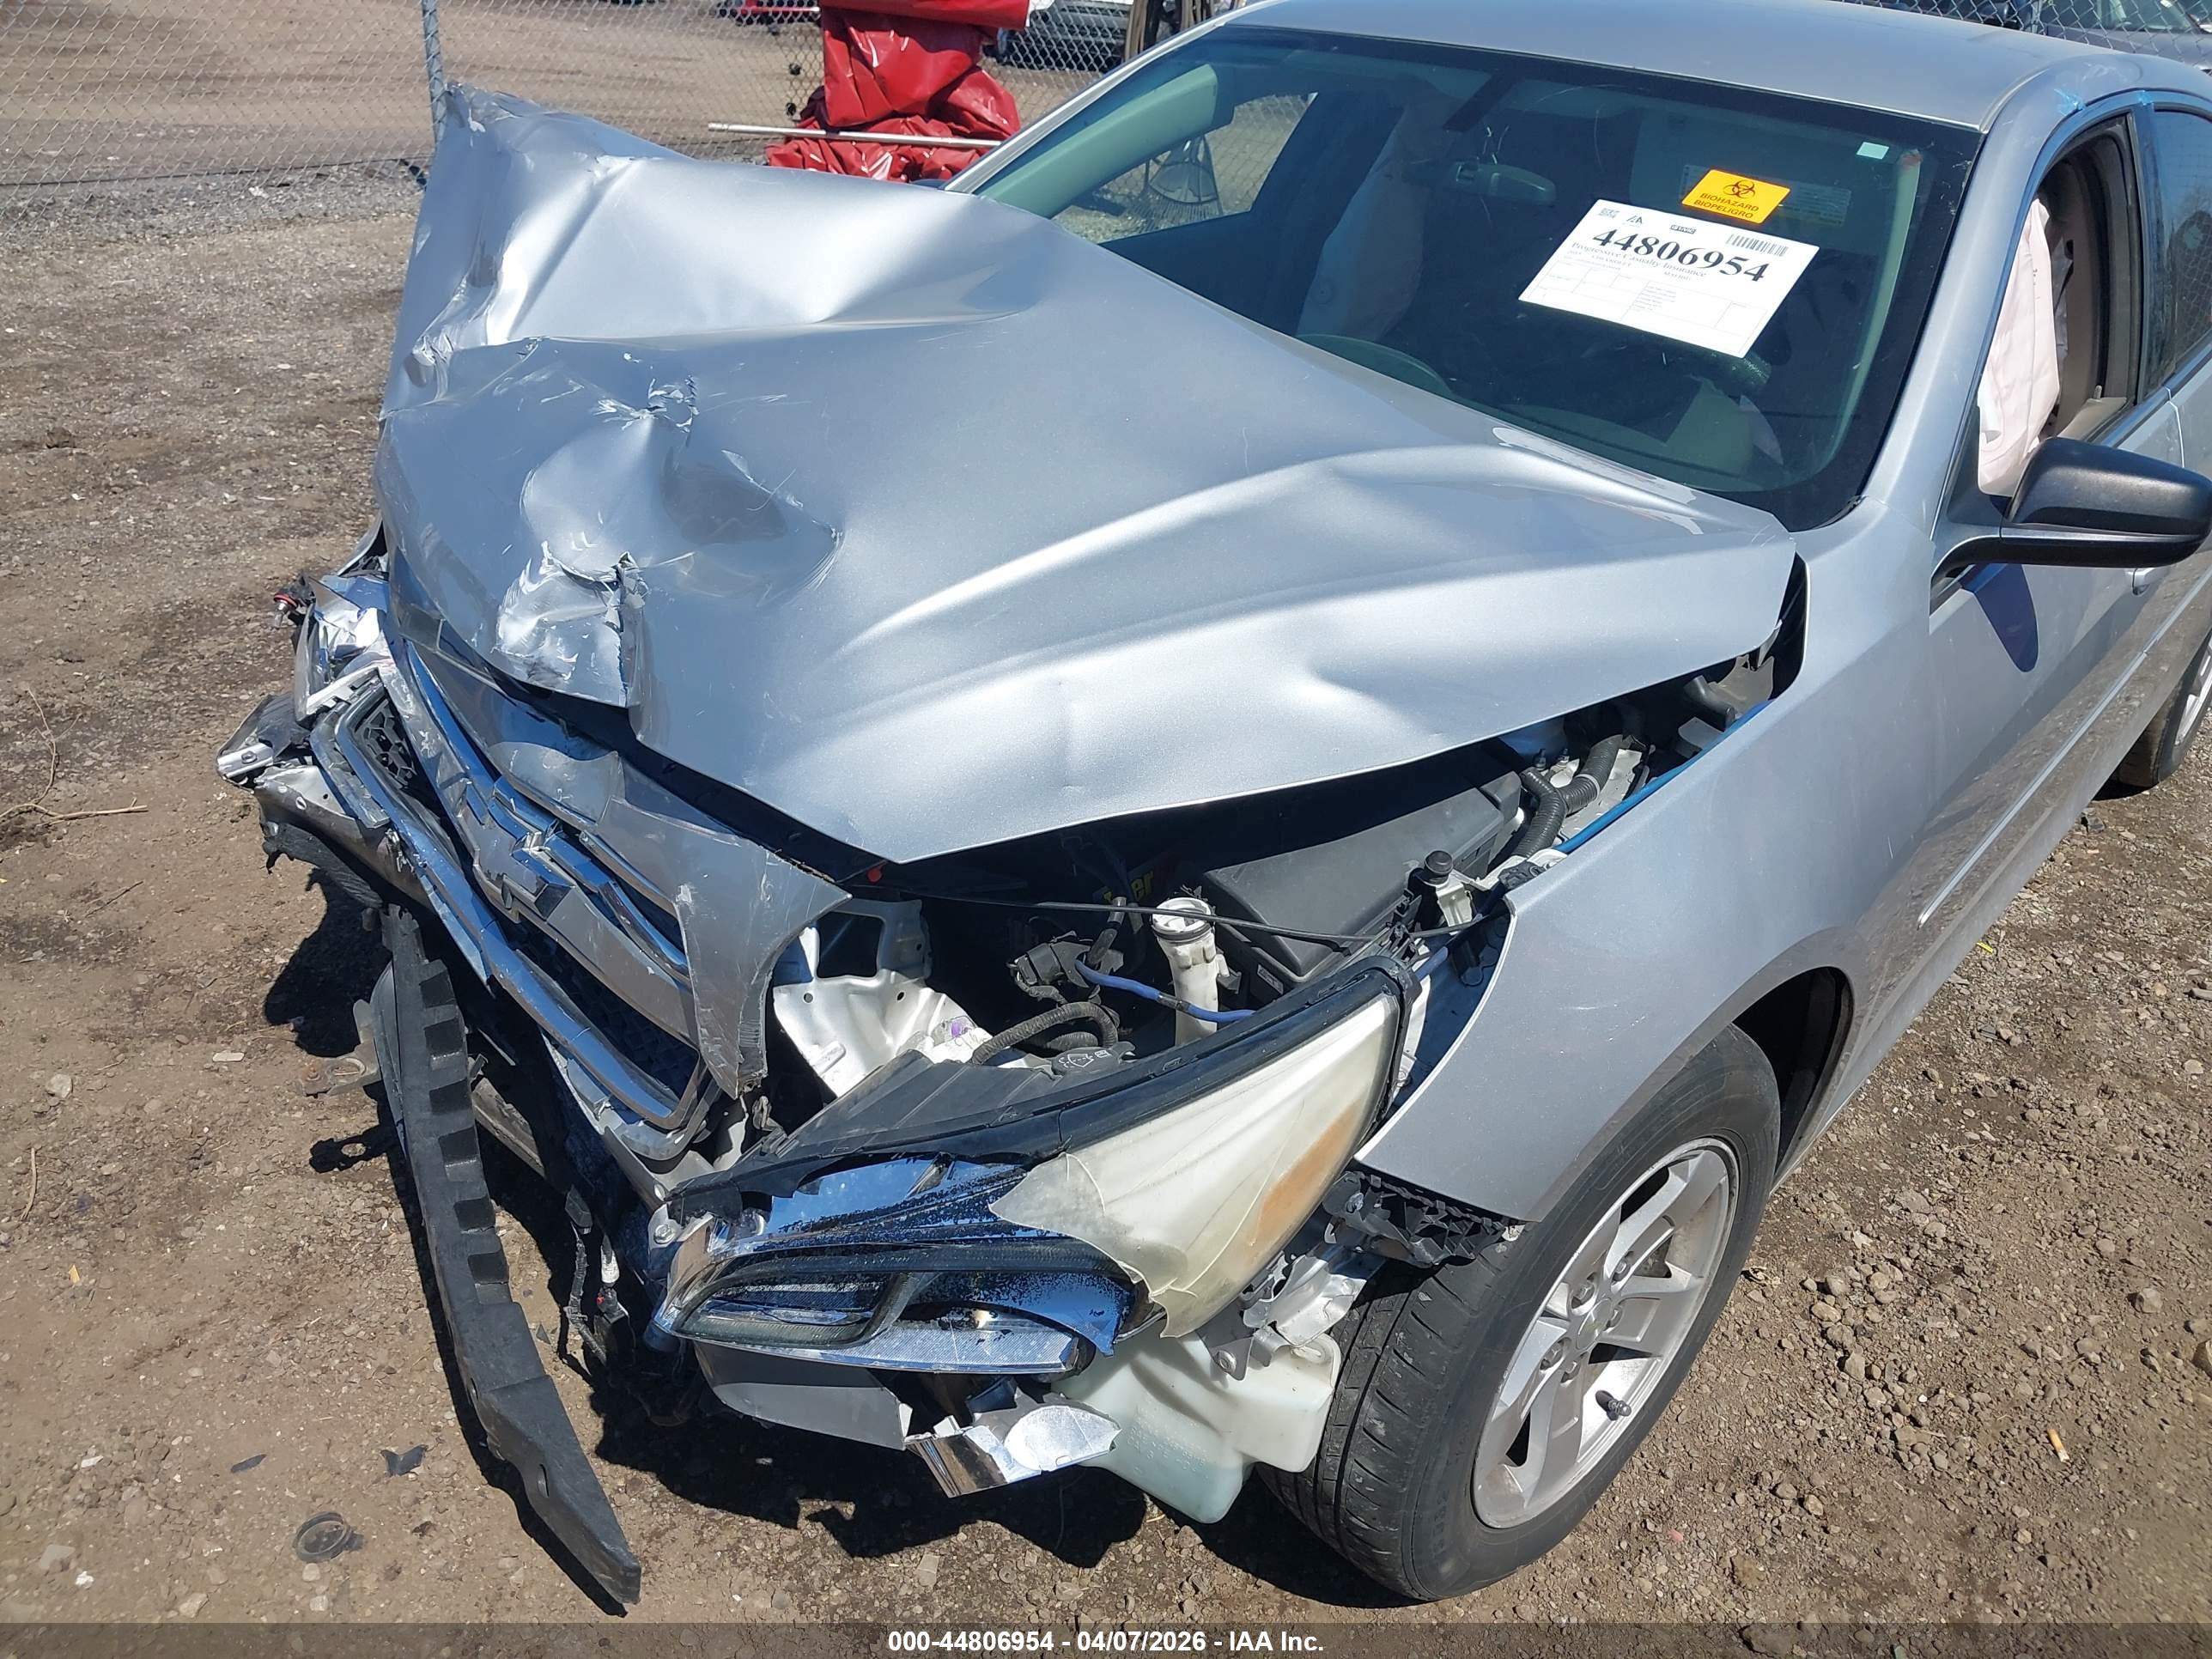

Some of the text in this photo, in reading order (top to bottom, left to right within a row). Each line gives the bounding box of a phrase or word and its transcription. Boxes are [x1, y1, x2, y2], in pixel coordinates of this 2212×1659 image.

[1693, 199, 1753, 219] BIOPELIGRO
[1700, 193, 1759, 212] BIOHAZARD
[1571, 241, 1622, 258] Progressive
[1621, 252, 1662, 268] Casualty
[1662, 261, 1707, 277] Insurance
[1592, 228, 1770, 282] 44806954
